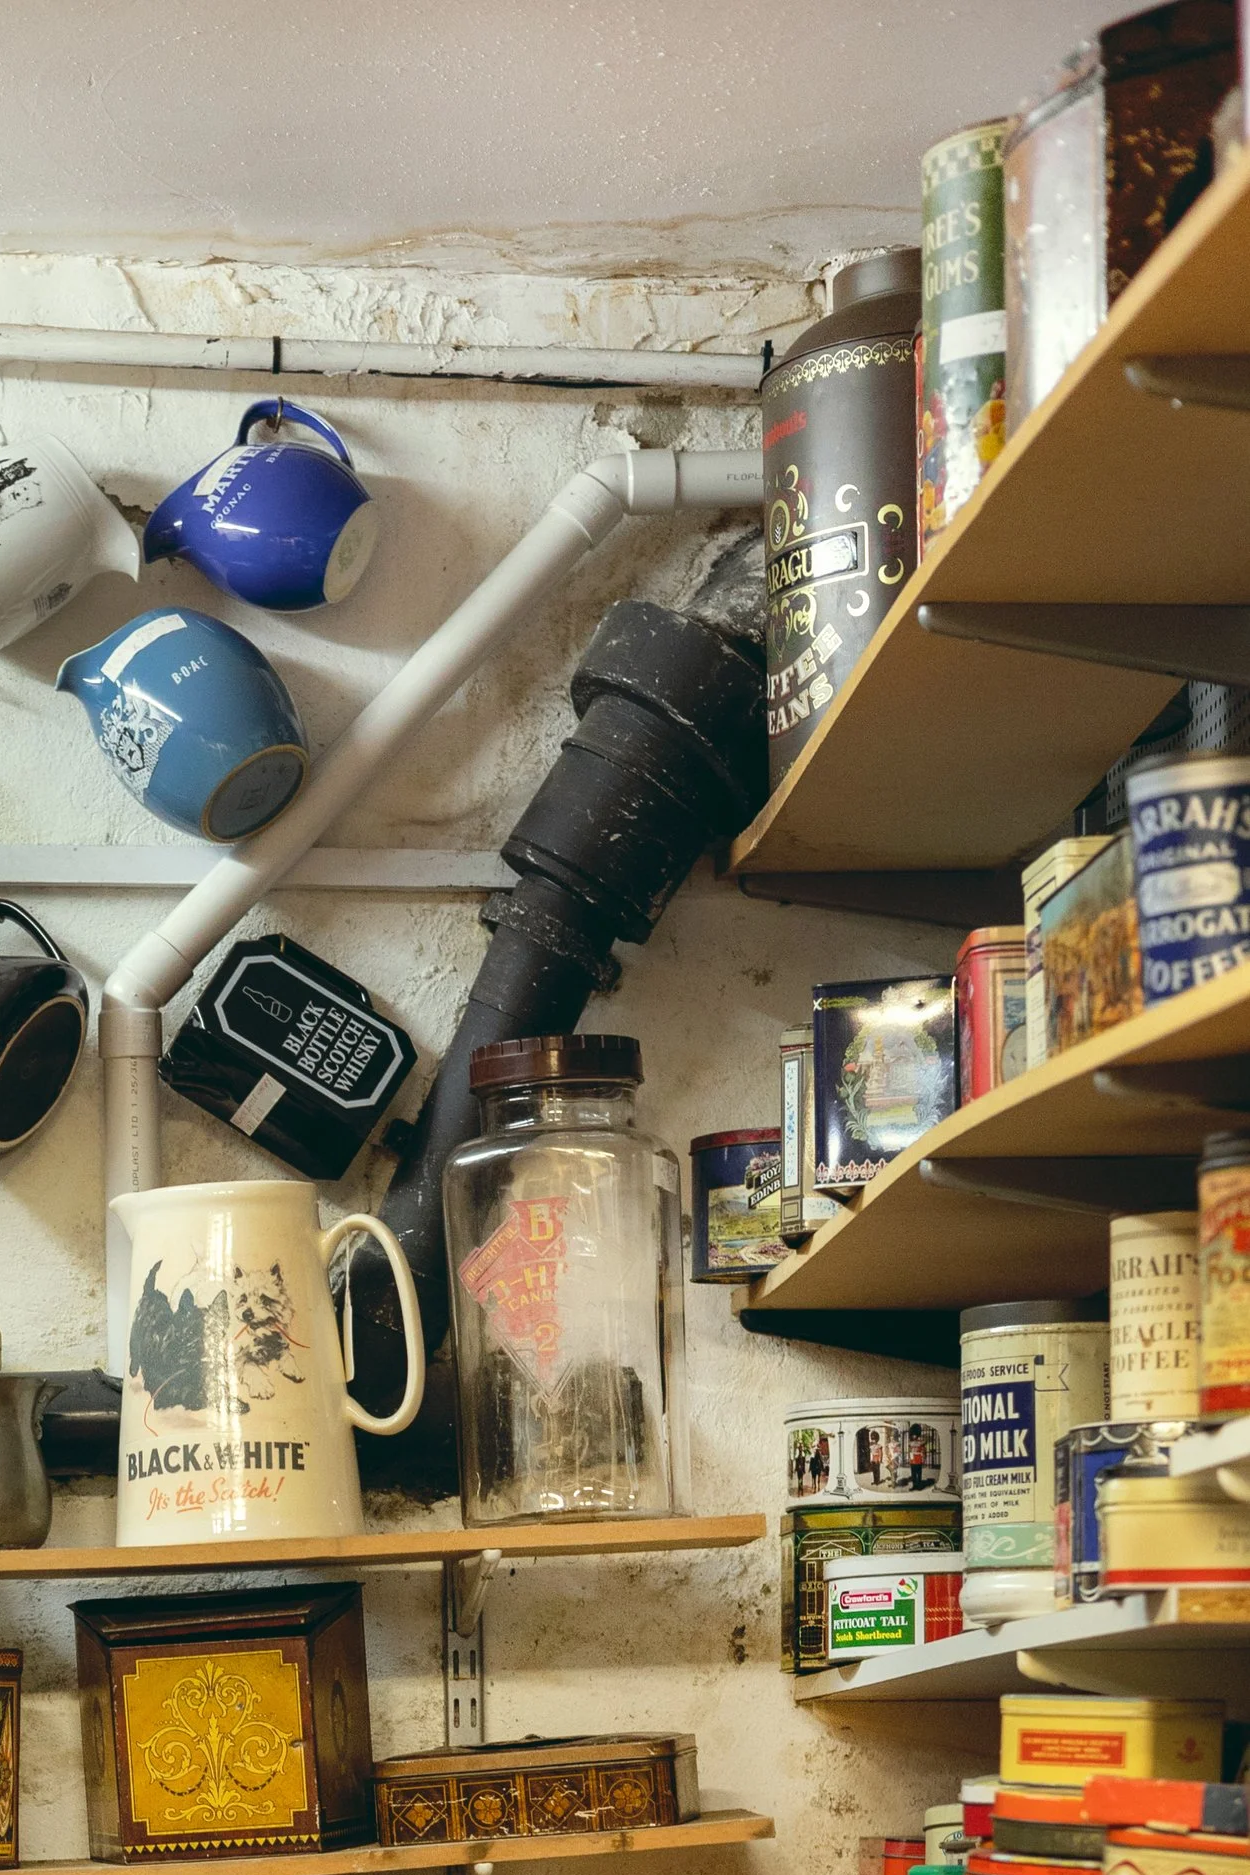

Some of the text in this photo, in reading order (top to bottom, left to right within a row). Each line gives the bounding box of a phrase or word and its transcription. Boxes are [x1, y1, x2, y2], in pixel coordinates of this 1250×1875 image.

[925, 250, 980, 301] GUMS
[211, 483, 253, 530] COGNAC
[282, 1000, 326, 1056] BLACK
[297, 1007, 348, 1075] BOTTLE
[317, 1017, 367, 1085] SCOTCH
[334, 1030, 382, 1093] WHISKY
[132, 1115, 140, 1138] LTD
[528, 1203, 554, 1242] B
[465, 1224, 519, 1283] DELIGHTFUL
[990, 1363, 1029, 1377] SERVICE
[1103, 1362, 1111, 1411] NOT START
[980, 1428, 1029, 1461] MILK
[203, 1453, 214, 1471] &
[985, 1473, 1009, 1486] CREAM
[1010, 1471, 1032, 1484] MILK
[175, 1480, 206, 1506] the
[989, 1488, 1031, 1498] EQUIVALENT
[1003, 1499, 1020, 1507] MILK
[988, 1511, 1009, 1519] ADDED
[820, 1549, 841, 1558] THE
[844, 1591, 890, 1606] Crawford's
[833, 1615, 908, 1631] PETTICOAT TAIL
[835, 1629, 903, 1643] Scotch Shortbread
